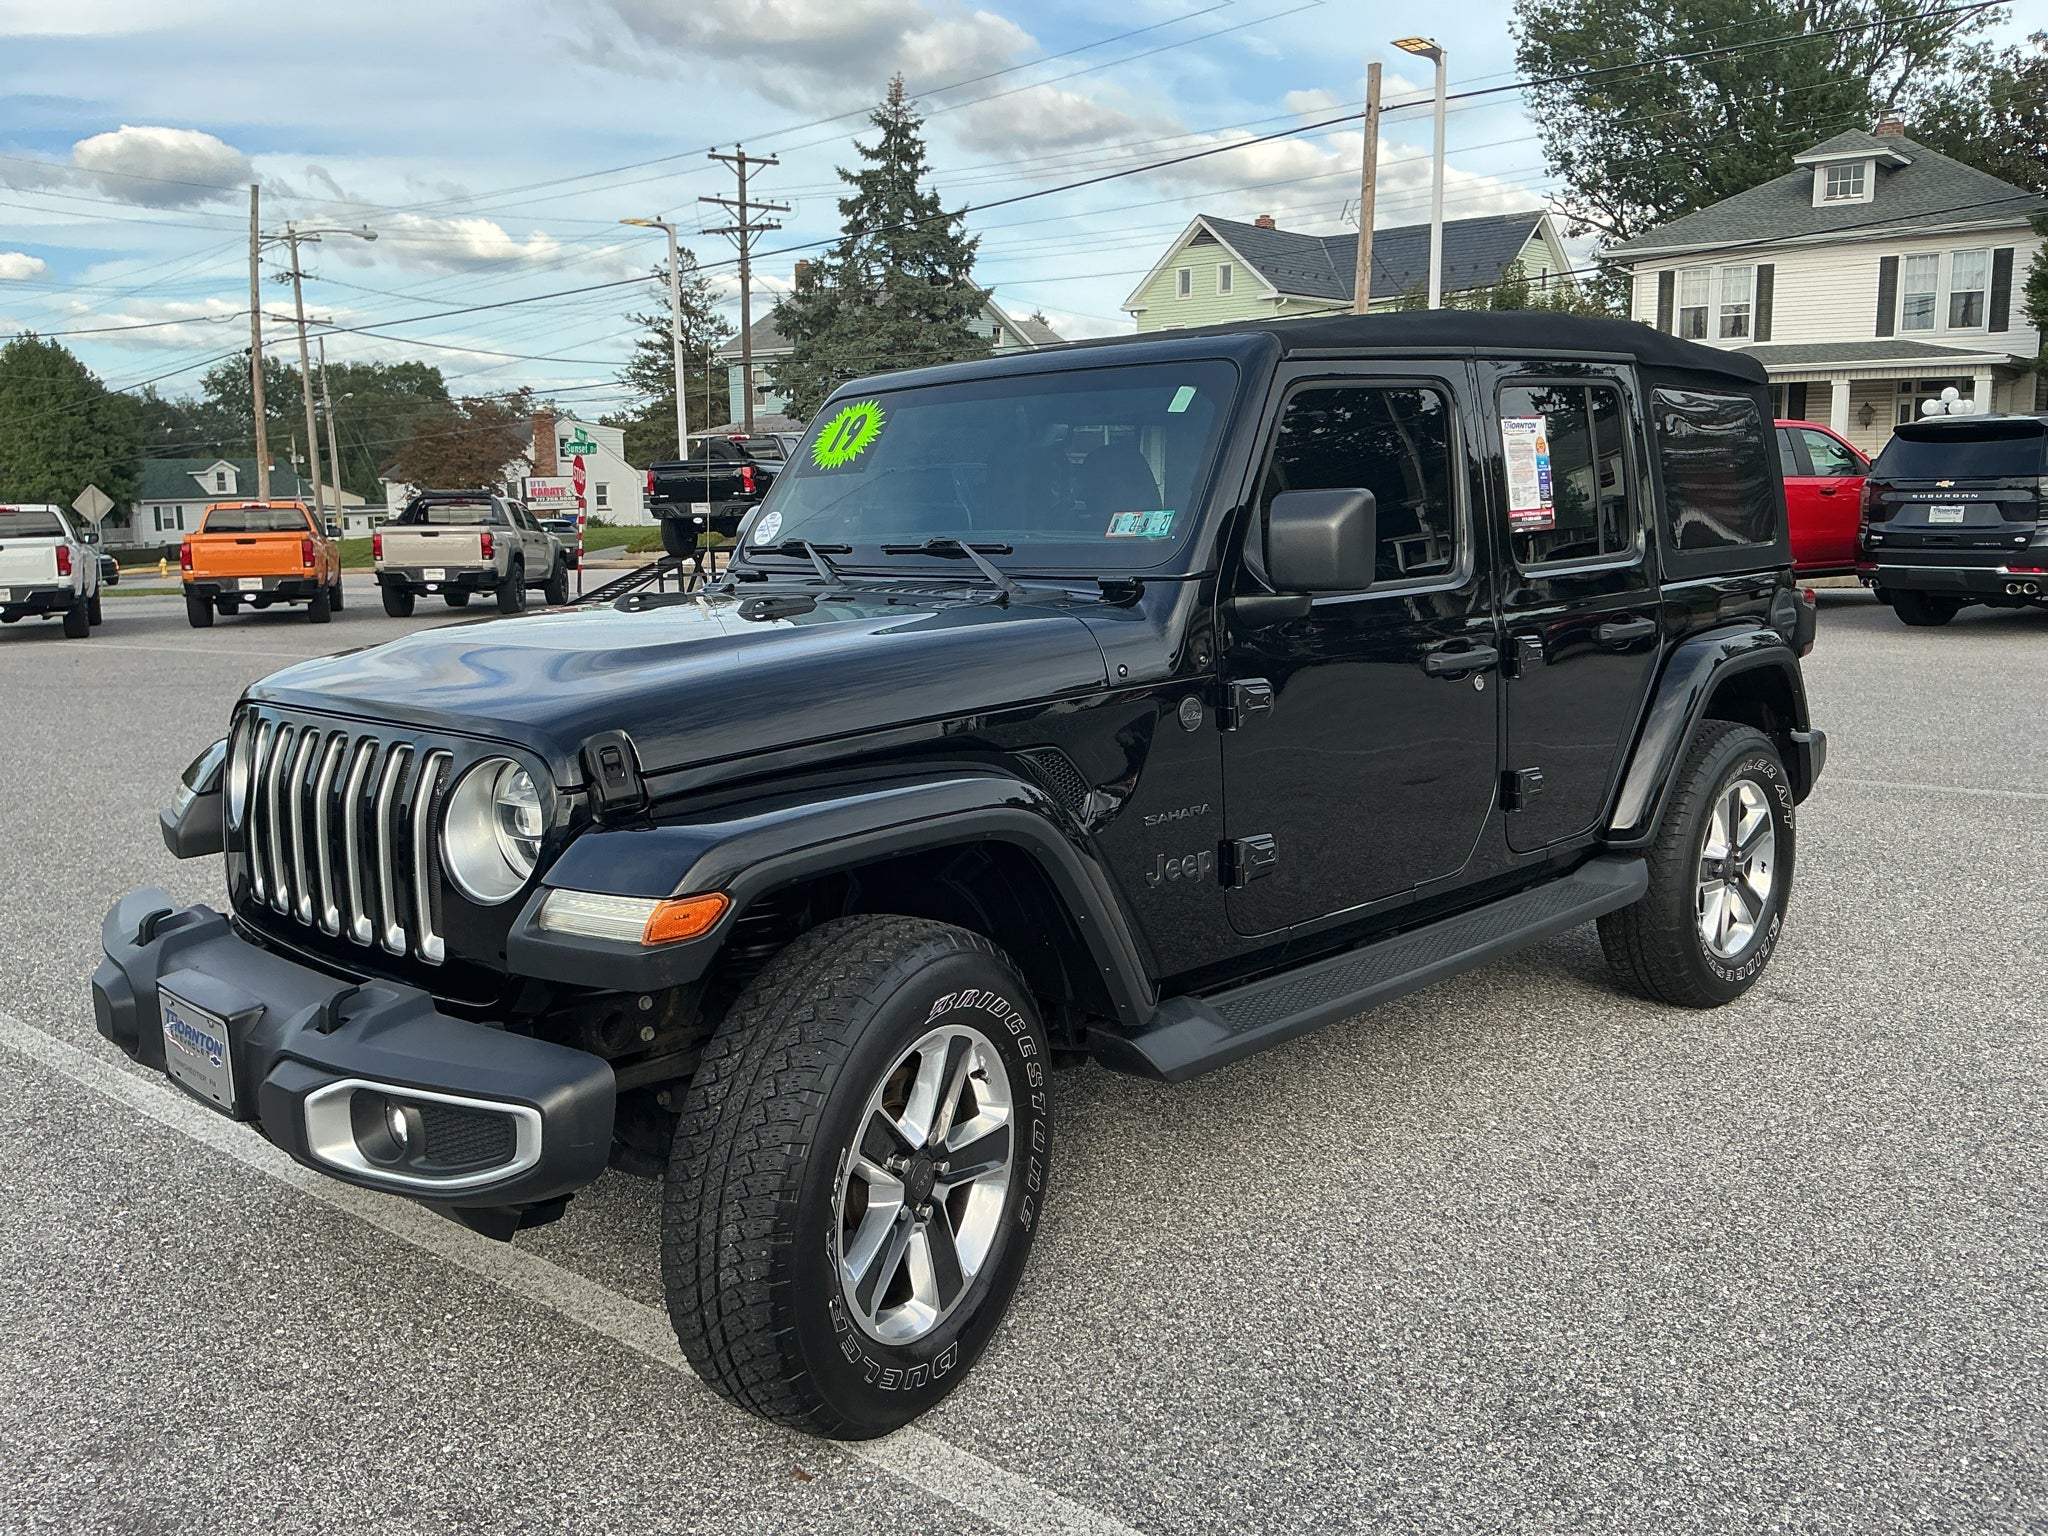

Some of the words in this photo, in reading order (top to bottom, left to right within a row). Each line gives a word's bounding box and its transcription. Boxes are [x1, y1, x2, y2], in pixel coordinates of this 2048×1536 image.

[828, 414, 868, 453] 19
[1503, 420, 1537, 430] THORNTON
[566, 443, 588, 453] Sunset
[573, 465, 586, 485] STOP
[530, 487, 565, 497] KARATE
[1143, 803, 1212, 827] SAHARA
[1145, 850, 1214, 889] Jeep
[164, 1007, 224, 1057] THORNTON
[924, 988, 1047, 1232] BRIDGESTONE
[828, 1294, 958, 1391] DUELER
